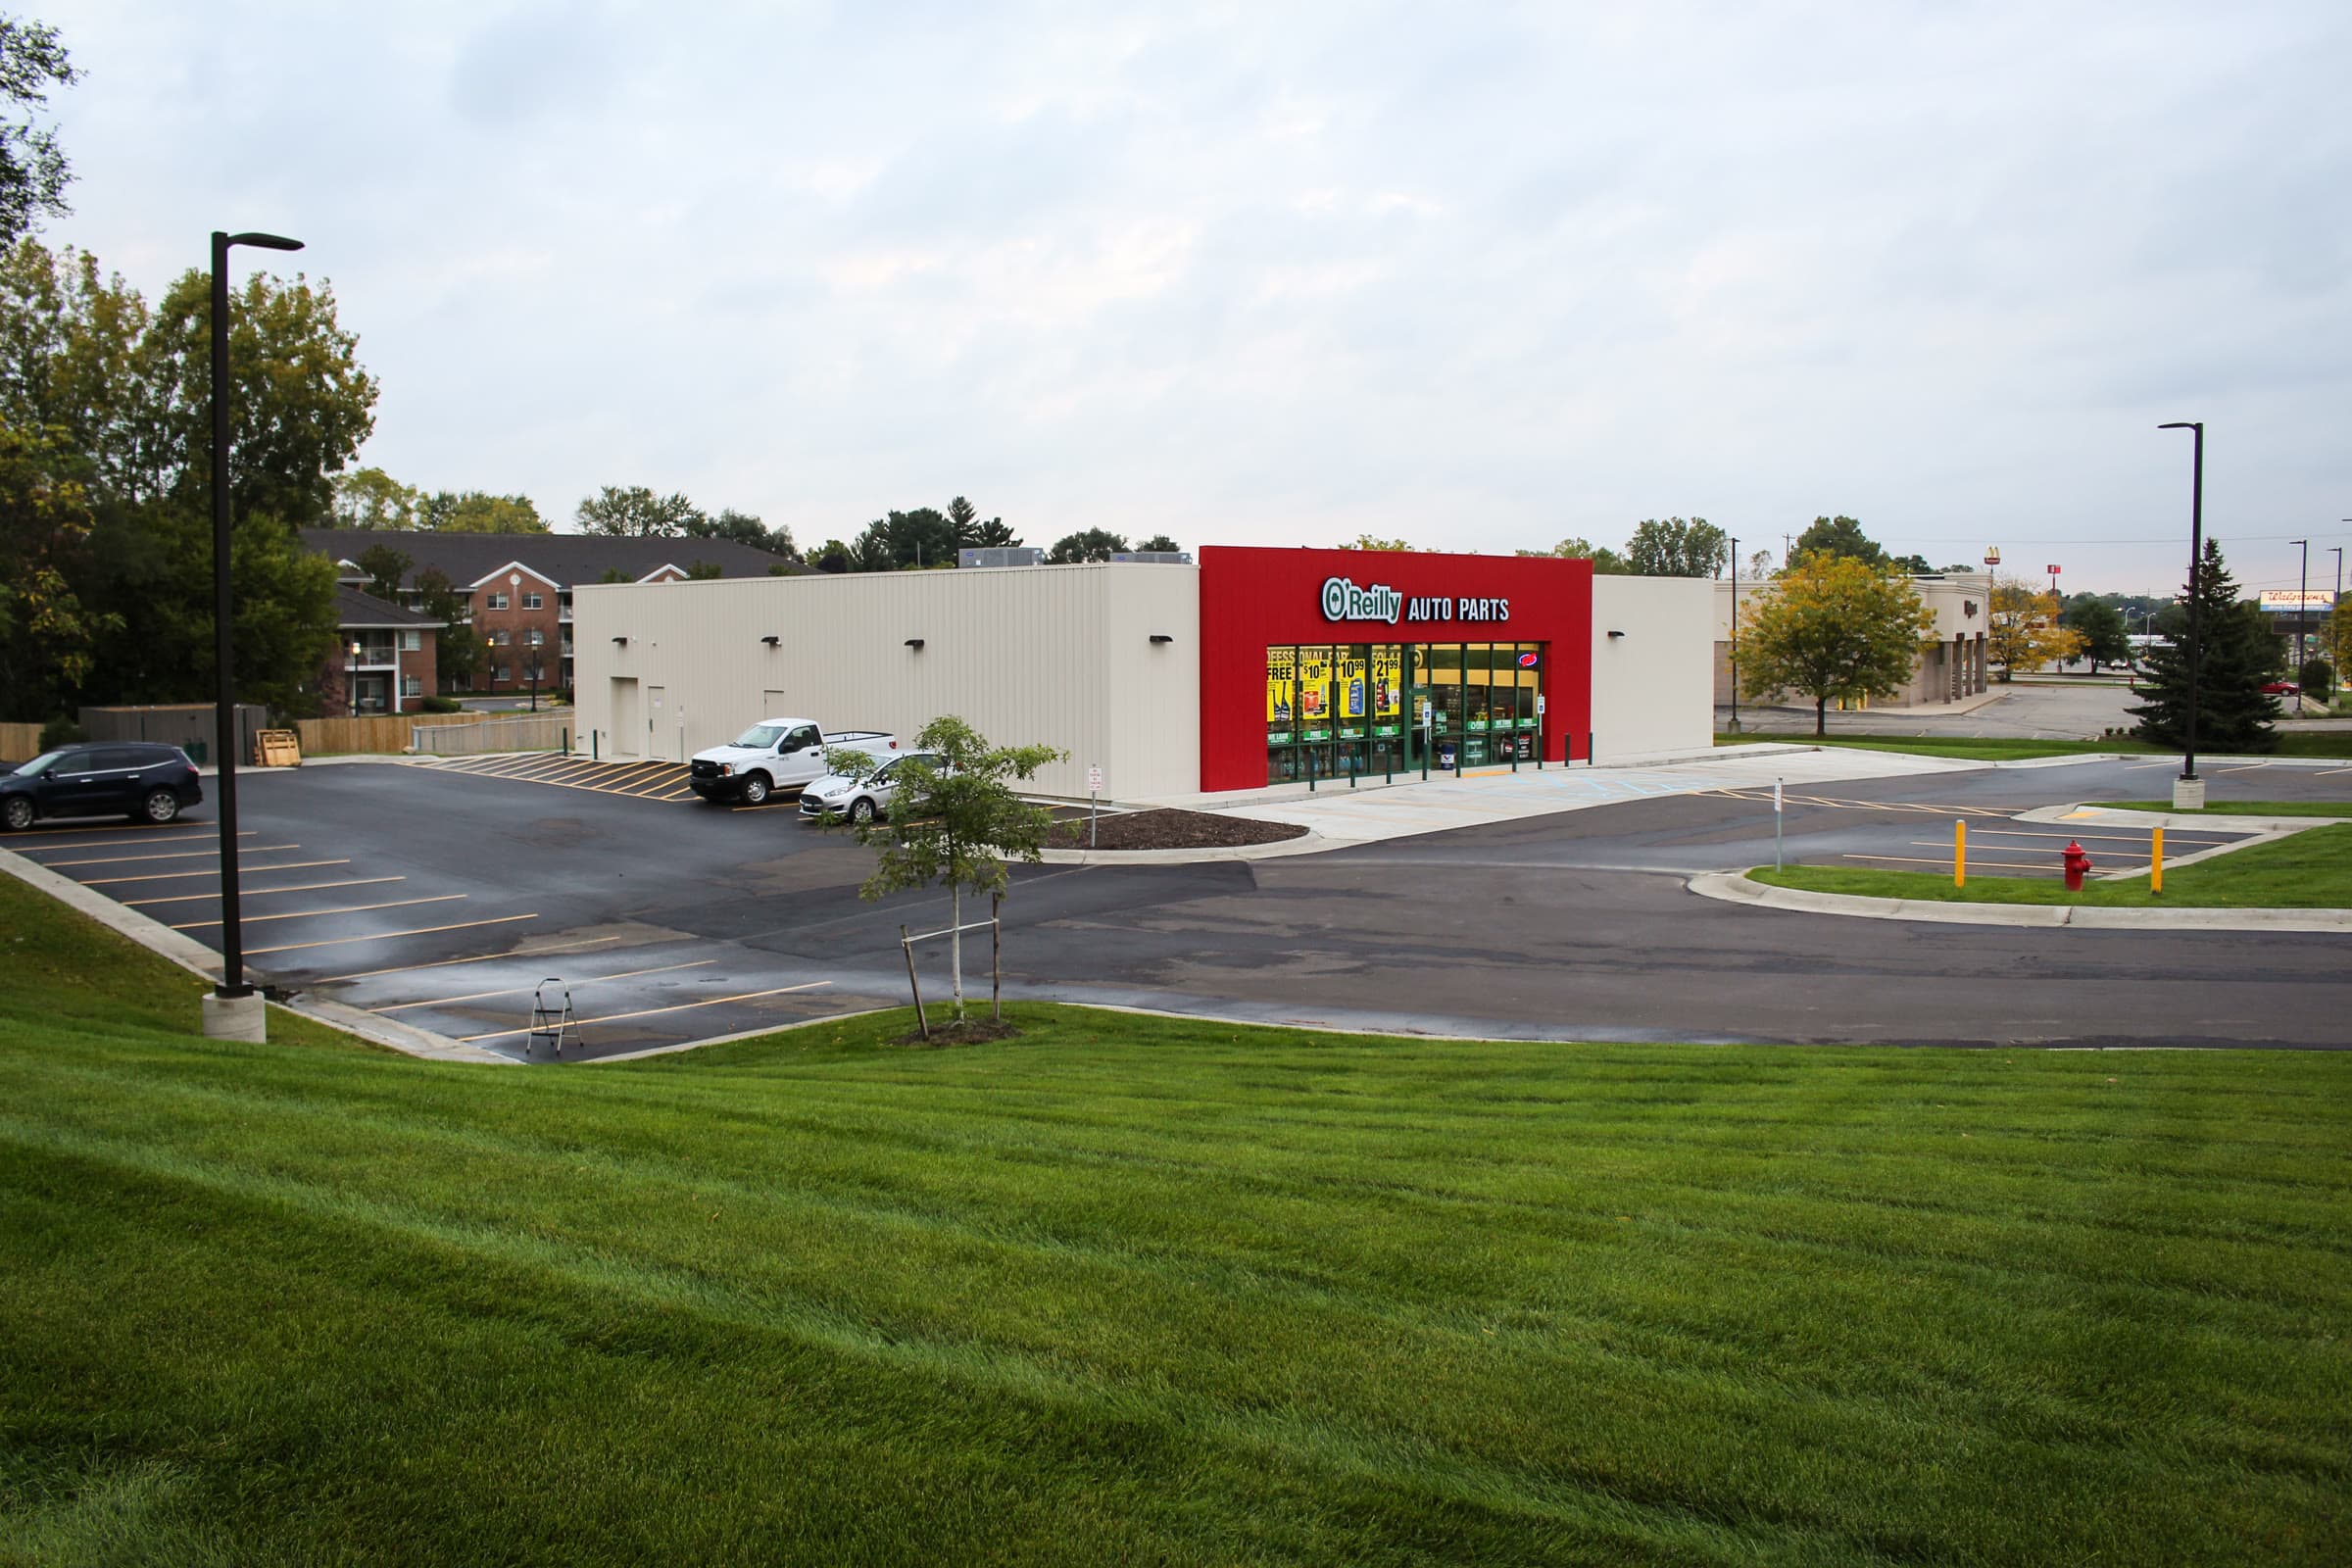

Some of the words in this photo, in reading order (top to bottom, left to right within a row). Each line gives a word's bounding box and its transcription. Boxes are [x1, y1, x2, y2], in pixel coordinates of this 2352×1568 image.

[1323, 577, 1402, 624] O'Reilly
[1407, 598, 1451, 620] AUTO
[1459, 599, 1509, 620] PARTS
[1267, 667, 1292, 680] FREE
[1303, 665, 1320, 679] $10
